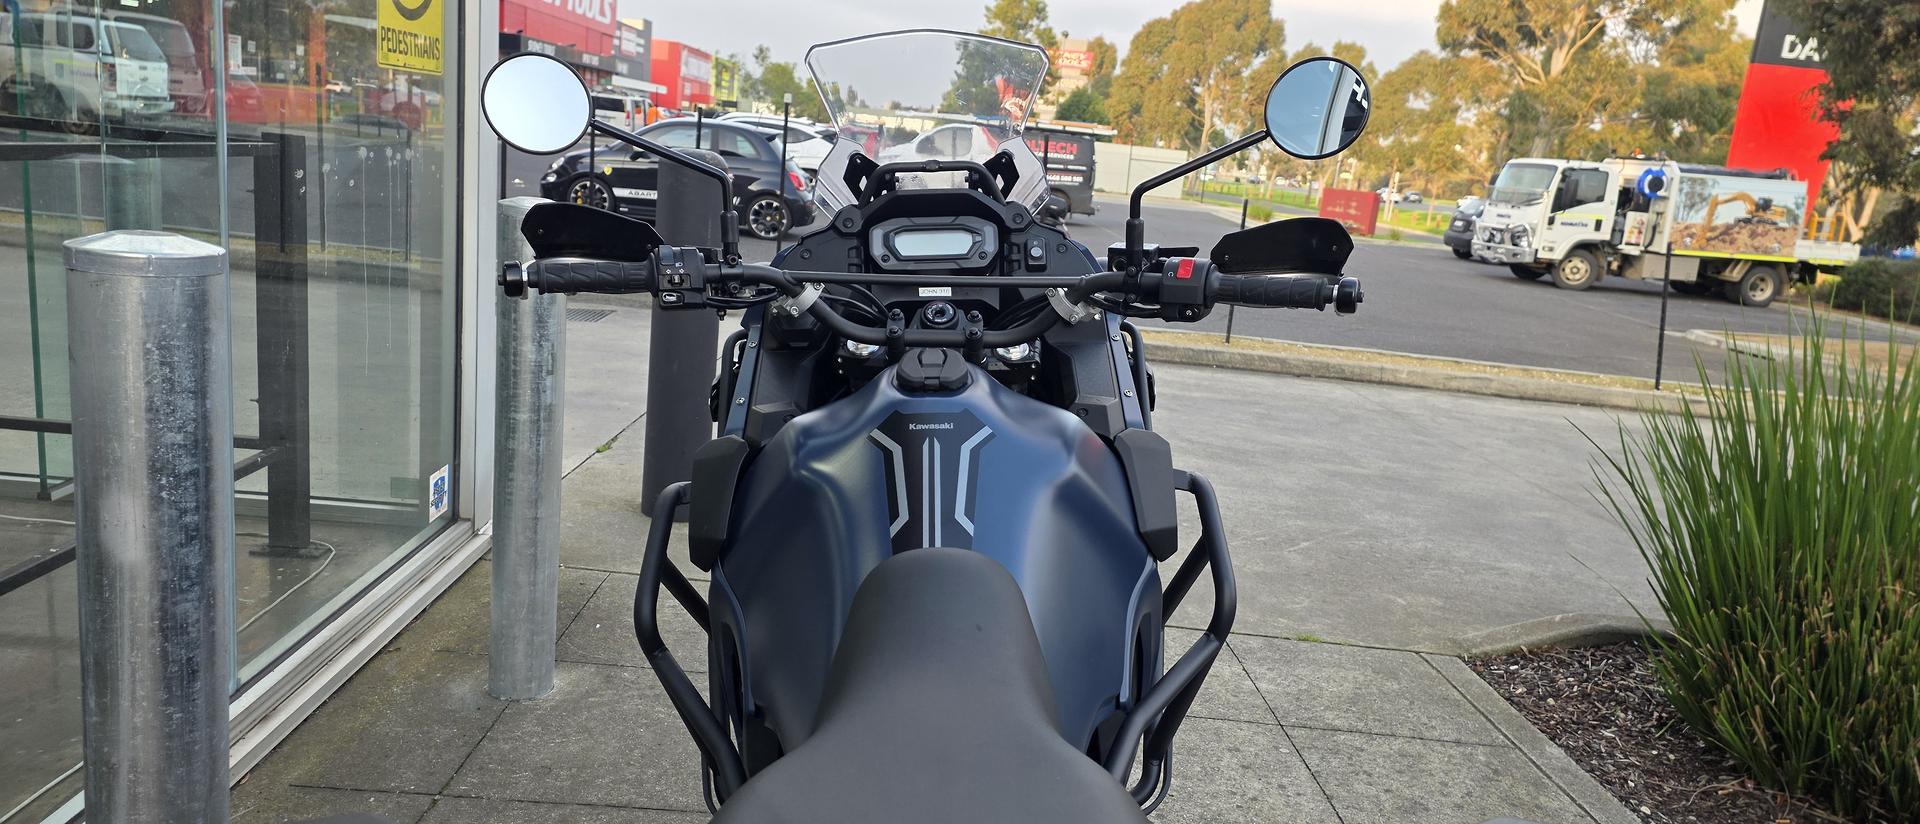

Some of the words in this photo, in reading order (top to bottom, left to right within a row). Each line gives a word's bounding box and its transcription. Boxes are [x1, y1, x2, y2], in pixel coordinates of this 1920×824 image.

[381, 26, 440, 61] PEDESTRIANS
[1781, 34, 1828, 62] DA
[909, 422, 953, 430] Kawasaki
